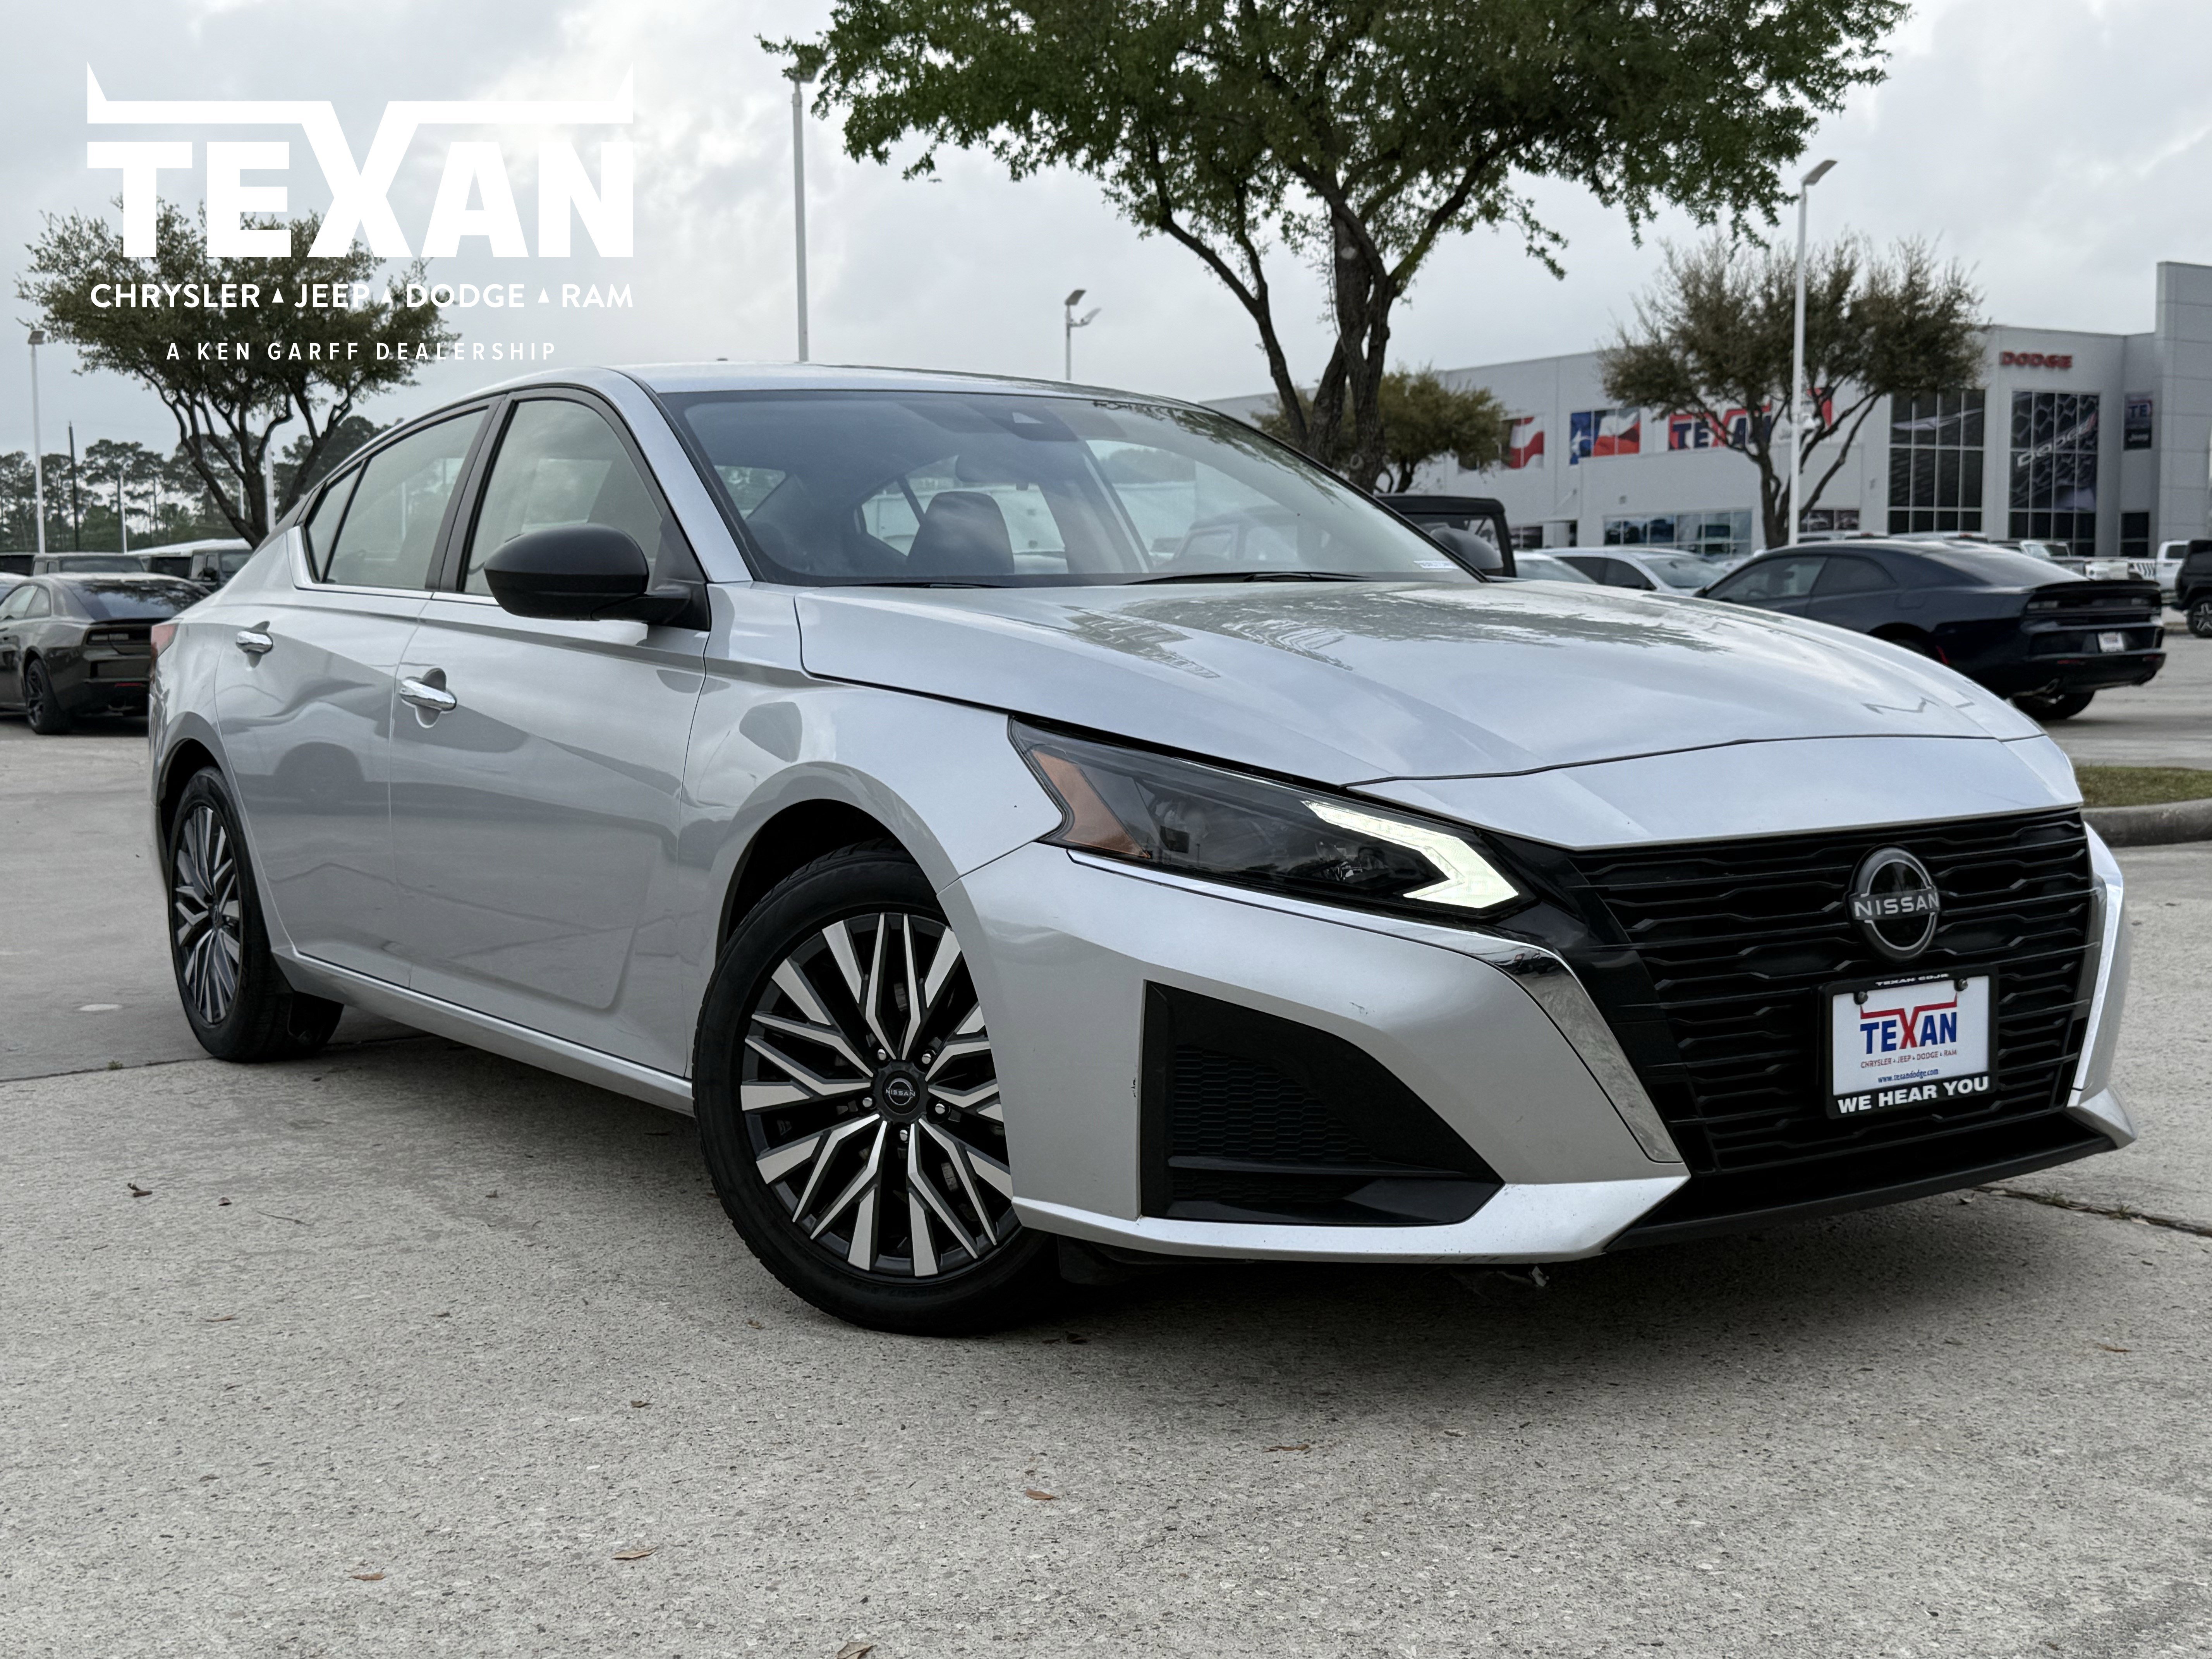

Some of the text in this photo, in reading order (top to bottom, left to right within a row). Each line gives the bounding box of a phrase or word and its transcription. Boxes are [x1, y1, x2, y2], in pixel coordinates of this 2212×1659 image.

[1999, 352, 2072, 370] DODGE
[2128, 403, 2152, 418] TE
[1854, 892, 1939, 917] NISSAN
[1875, 977, 1915, 986] TEXAN
[1860, 1005, 1957, 1054] TEXAN
[1860, 1058, 1892, 1068] CHRYSLER
[1898, 1055, 1911, 1063] JEEP
[1917, 1051, 1939, 1060] DODGE
[1838, 1076, 1989, 1114] WE HEAR YOU
